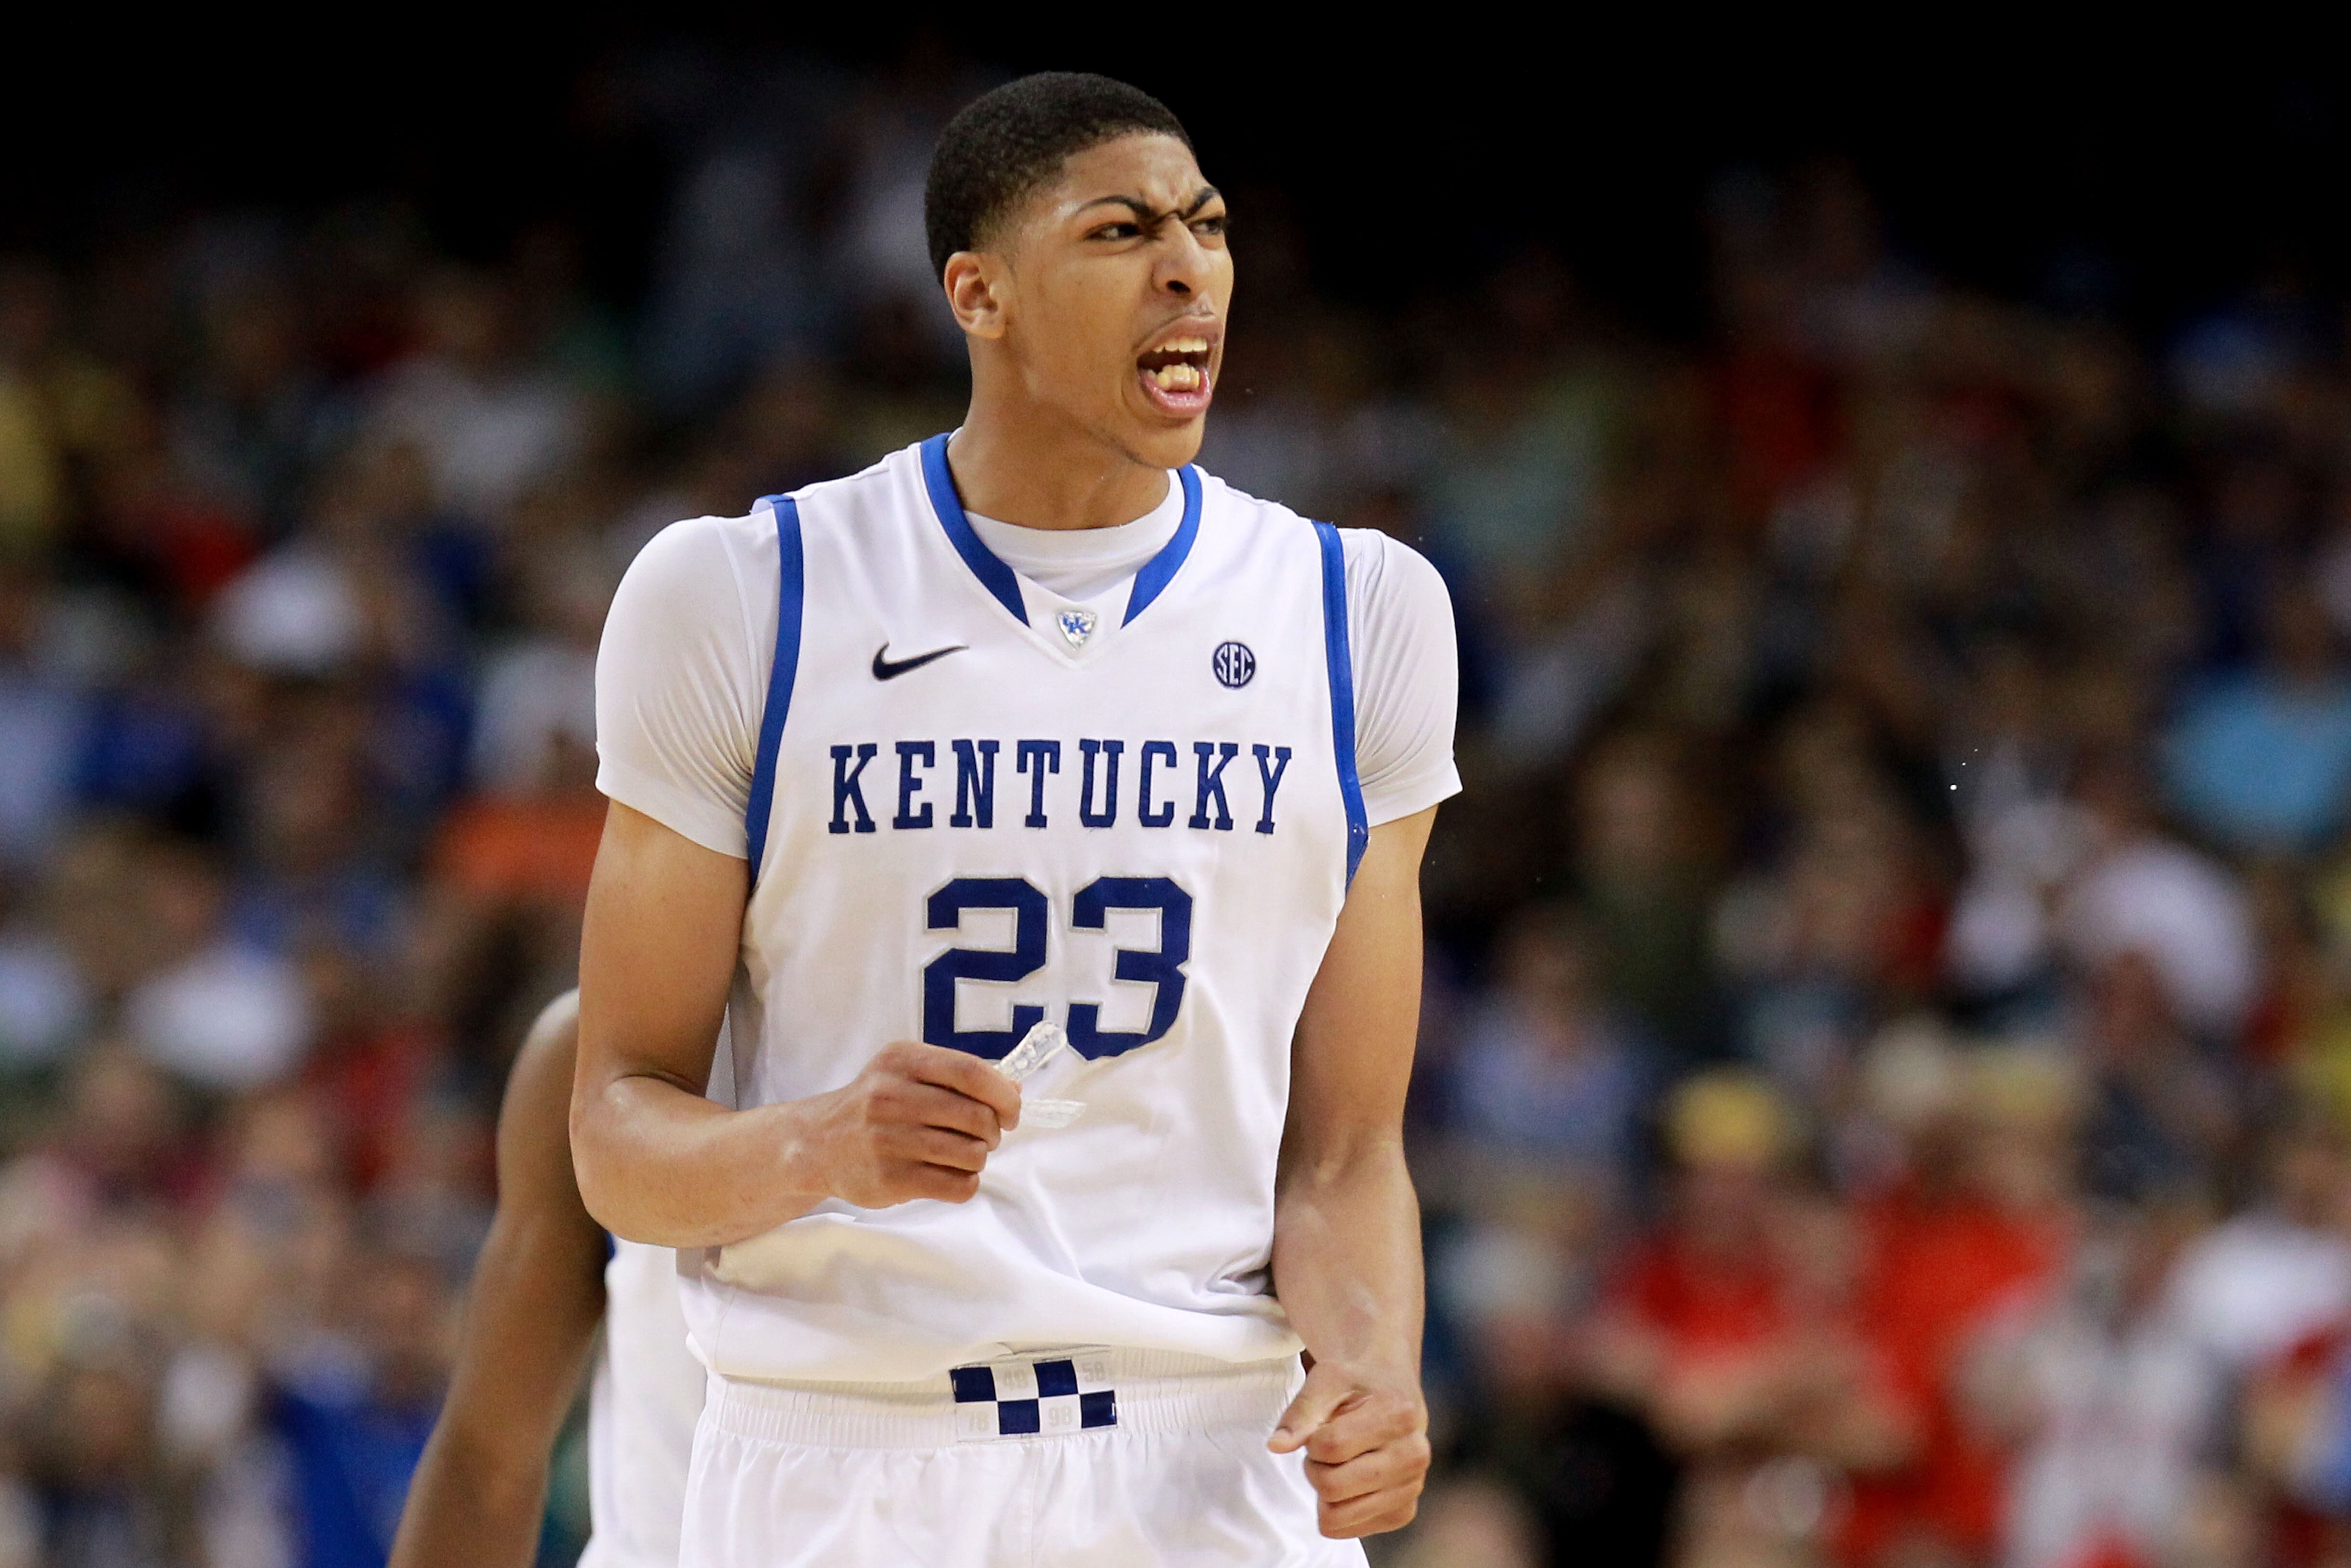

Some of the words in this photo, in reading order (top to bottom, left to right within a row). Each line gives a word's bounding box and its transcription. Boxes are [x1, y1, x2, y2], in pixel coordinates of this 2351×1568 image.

[1216, 644, 1252, 684] SEC
[828, 739, 1292, 835] KENTUCKY
[921, 876, 1194, 1062] 23
